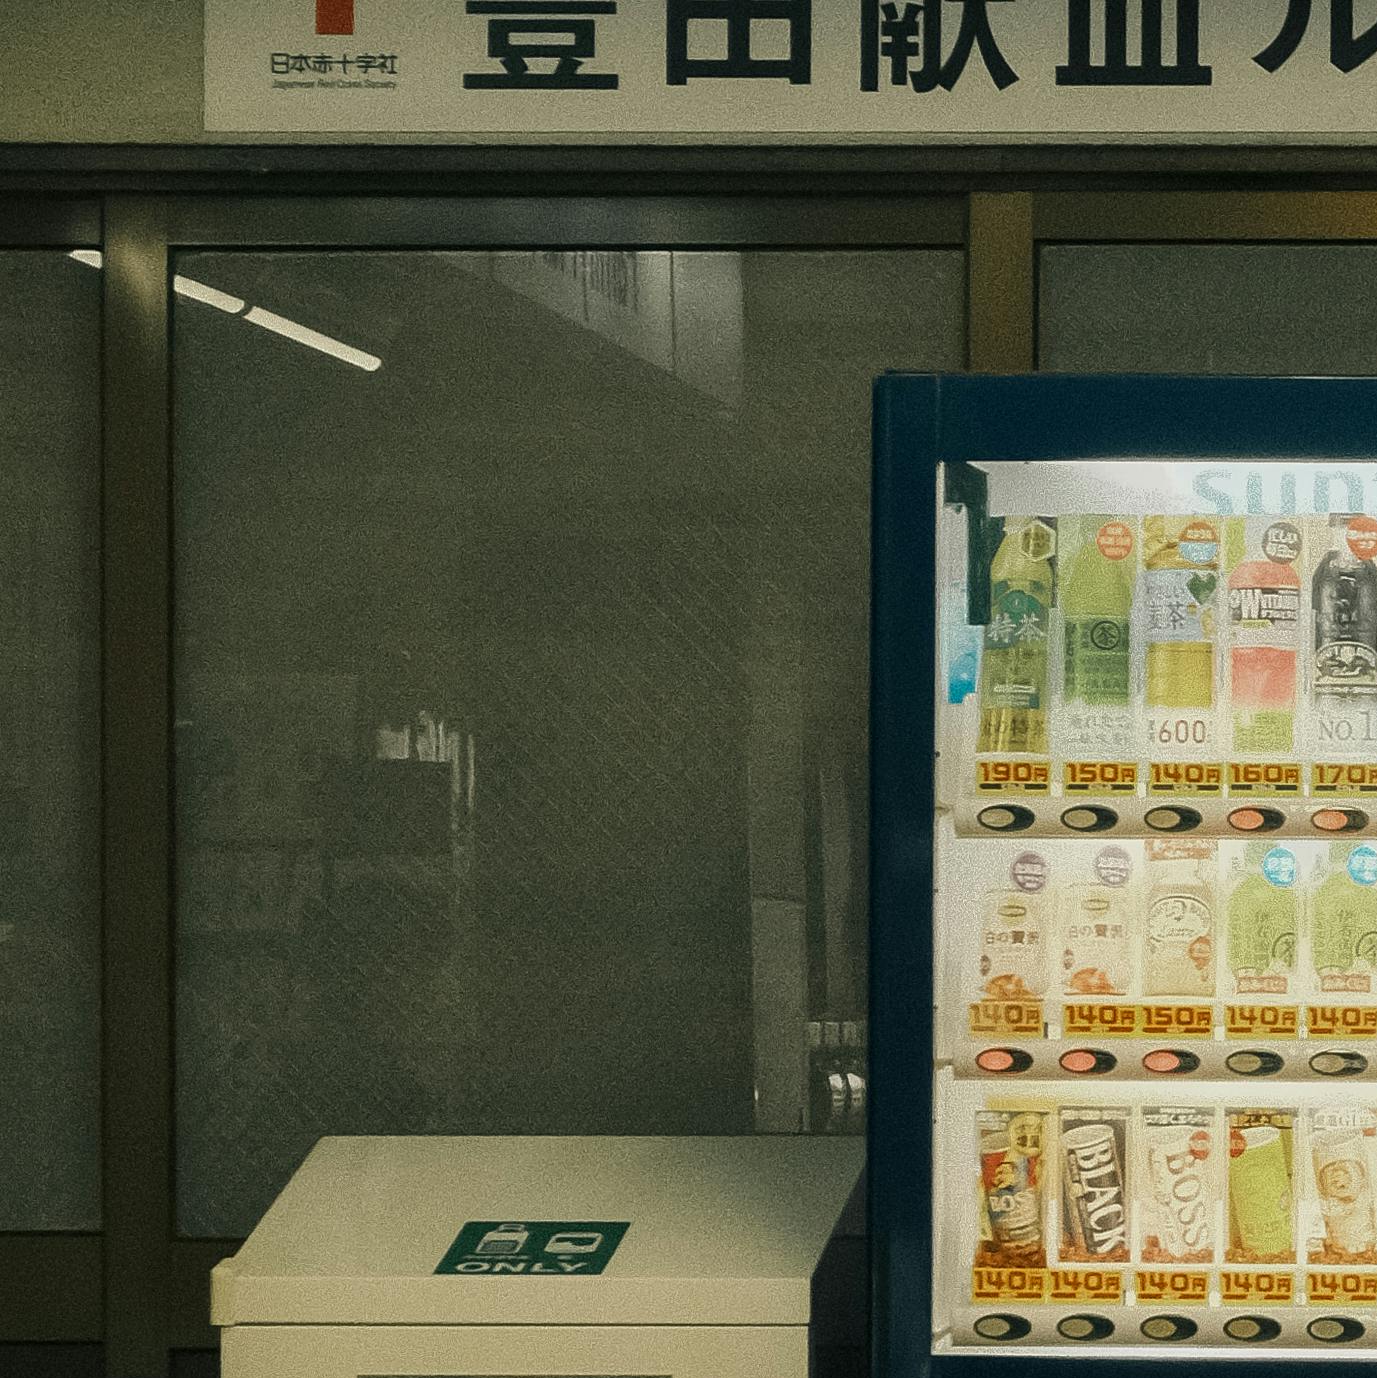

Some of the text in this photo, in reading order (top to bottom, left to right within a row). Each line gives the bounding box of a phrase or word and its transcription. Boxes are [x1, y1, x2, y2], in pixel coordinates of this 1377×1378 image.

[271, 52, 398, 74] 日本赤十字社
[979, 763, 1048, 783] 190円
[1066, 763, 1136, 783] 150円
[1152, 764, 1221, 784] 140円
[1232, 765, 1299, 784] 160円
[1067, 1006, 1135, 1025] 140円
[1144, 1006, 1211, 1025] 150円
[1227, 1006, 1296, 1026] 140円
[1311, 1006, 1377, 1026] 140円
[1075, 1144, 1127, 1256] BLACK
[1165, 1151, 1209, 1248] BOSS
[456, 1261, 588, 1273] ONLY
[975, 1270, 1044, 1291] 140円
[1051, 1270, 1120, 1291] 140円
[1137, 1270, 1206, 1291] 140円
[1222, 1270, 1291, 1291] 140円
